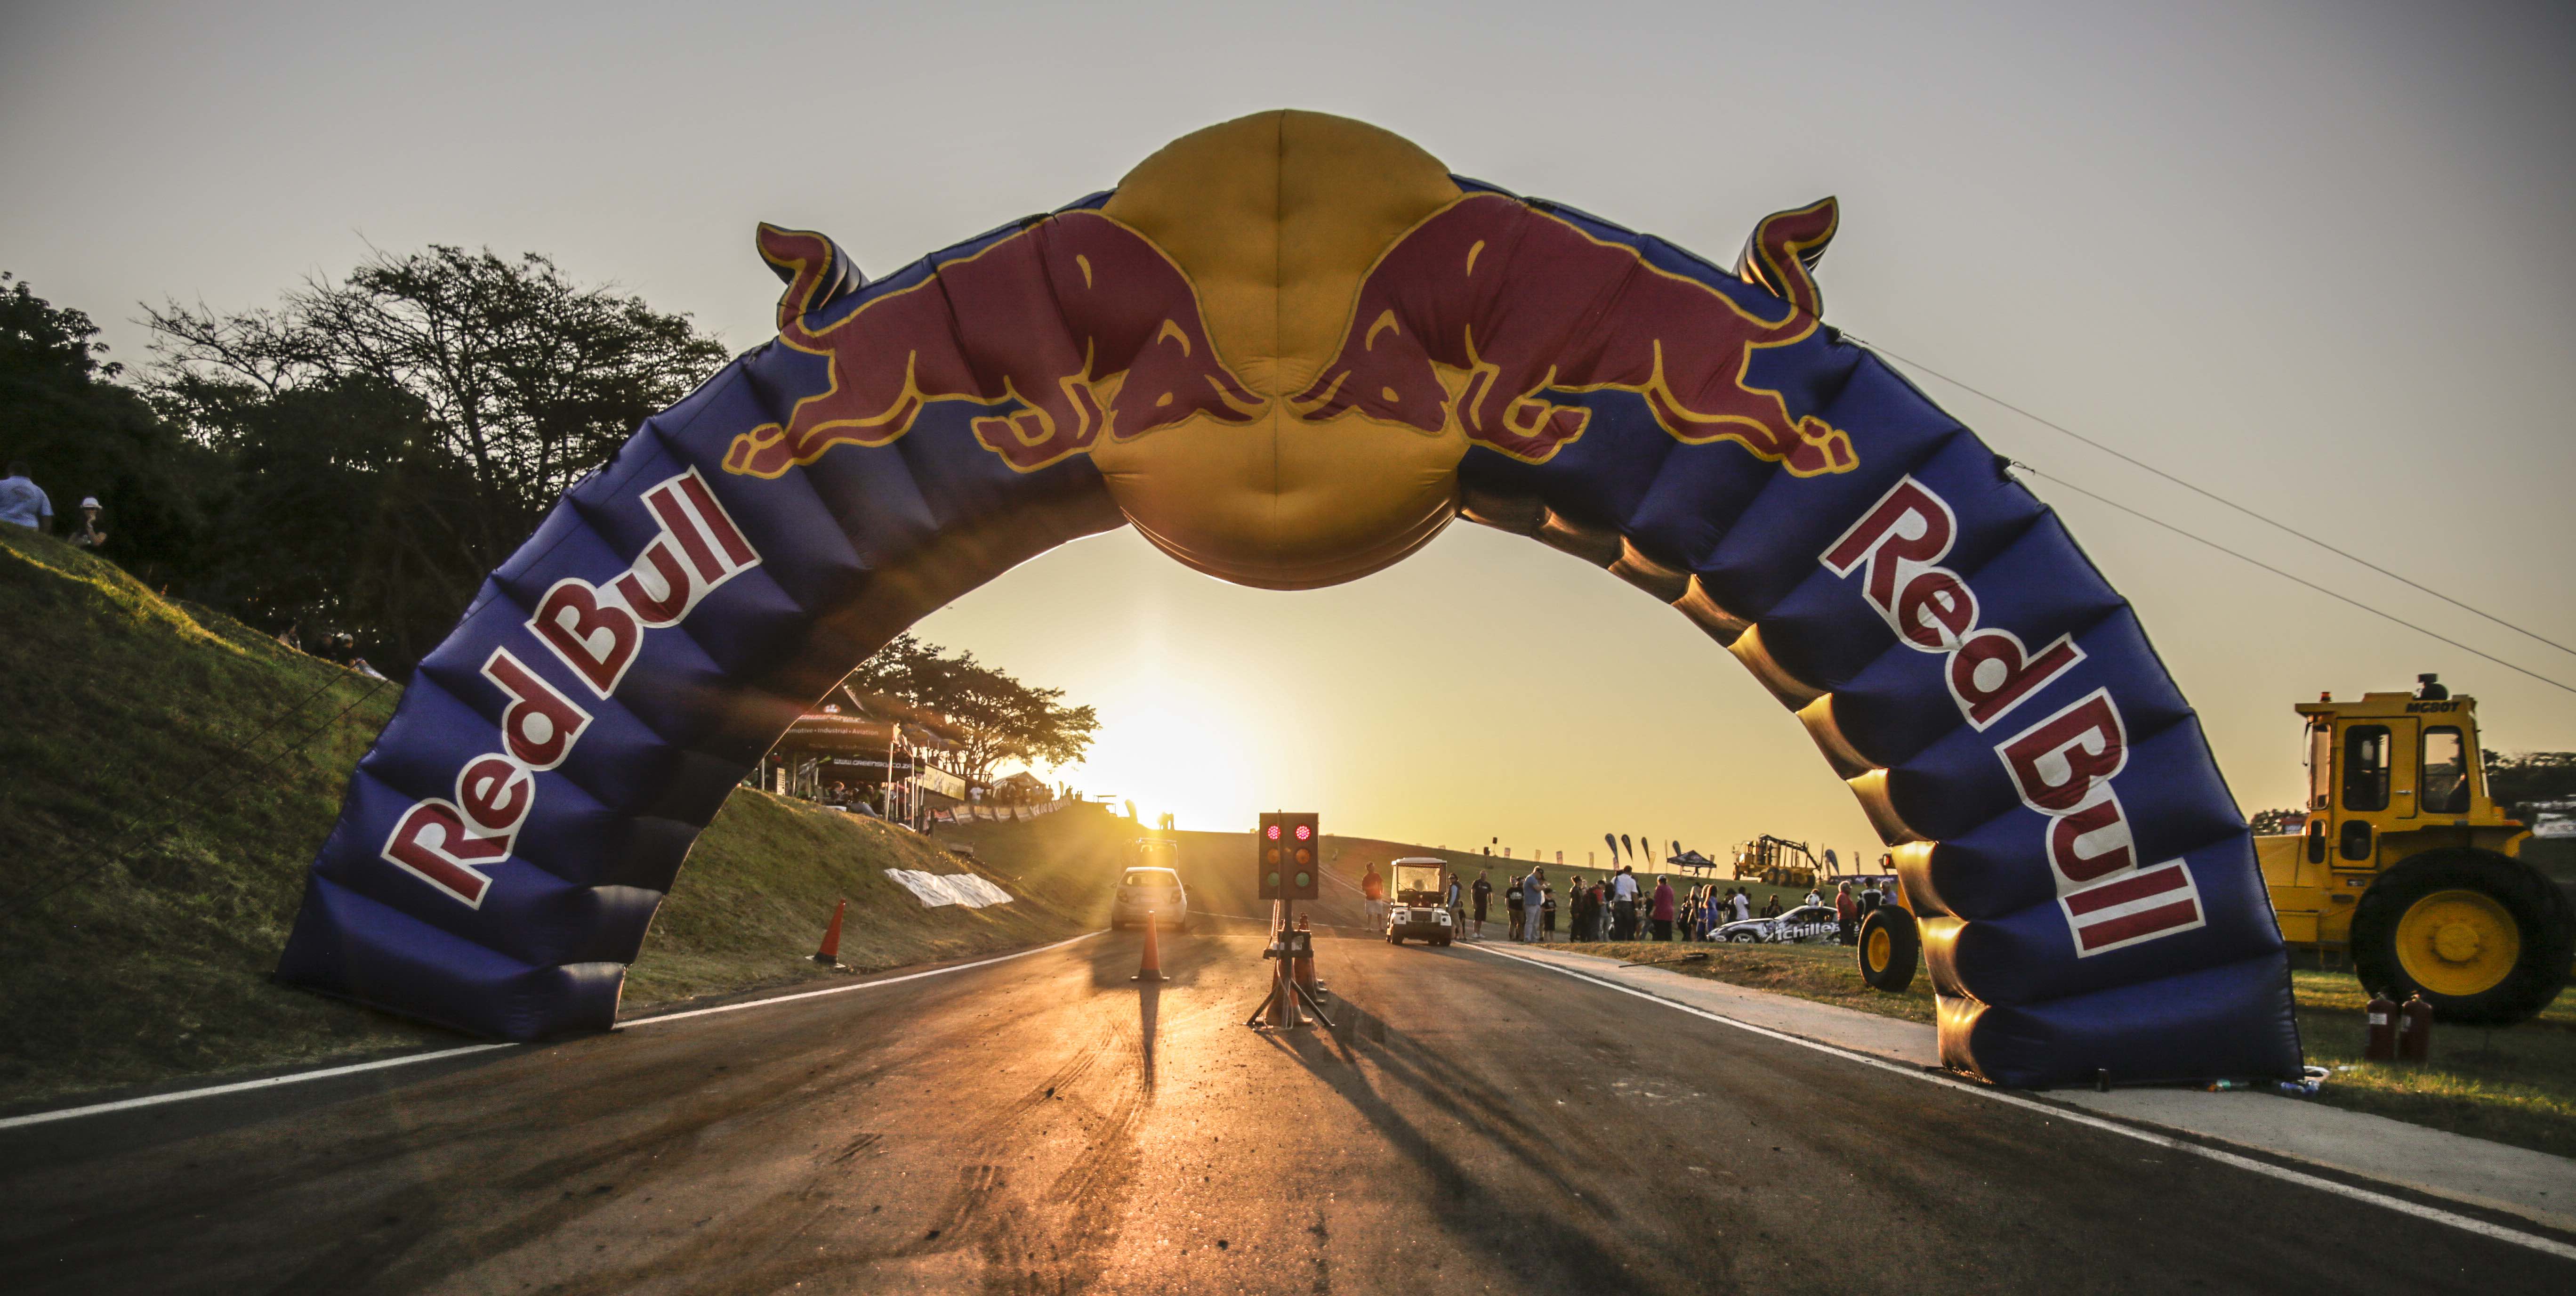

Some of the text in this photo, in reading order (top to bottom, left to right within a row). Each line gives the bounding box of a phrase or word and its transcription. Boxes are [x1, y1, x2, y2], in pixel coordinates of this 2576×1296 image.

[381, 464, 763, 910] Red Bull
[1818, 473, 2206, 958] Red Bull
